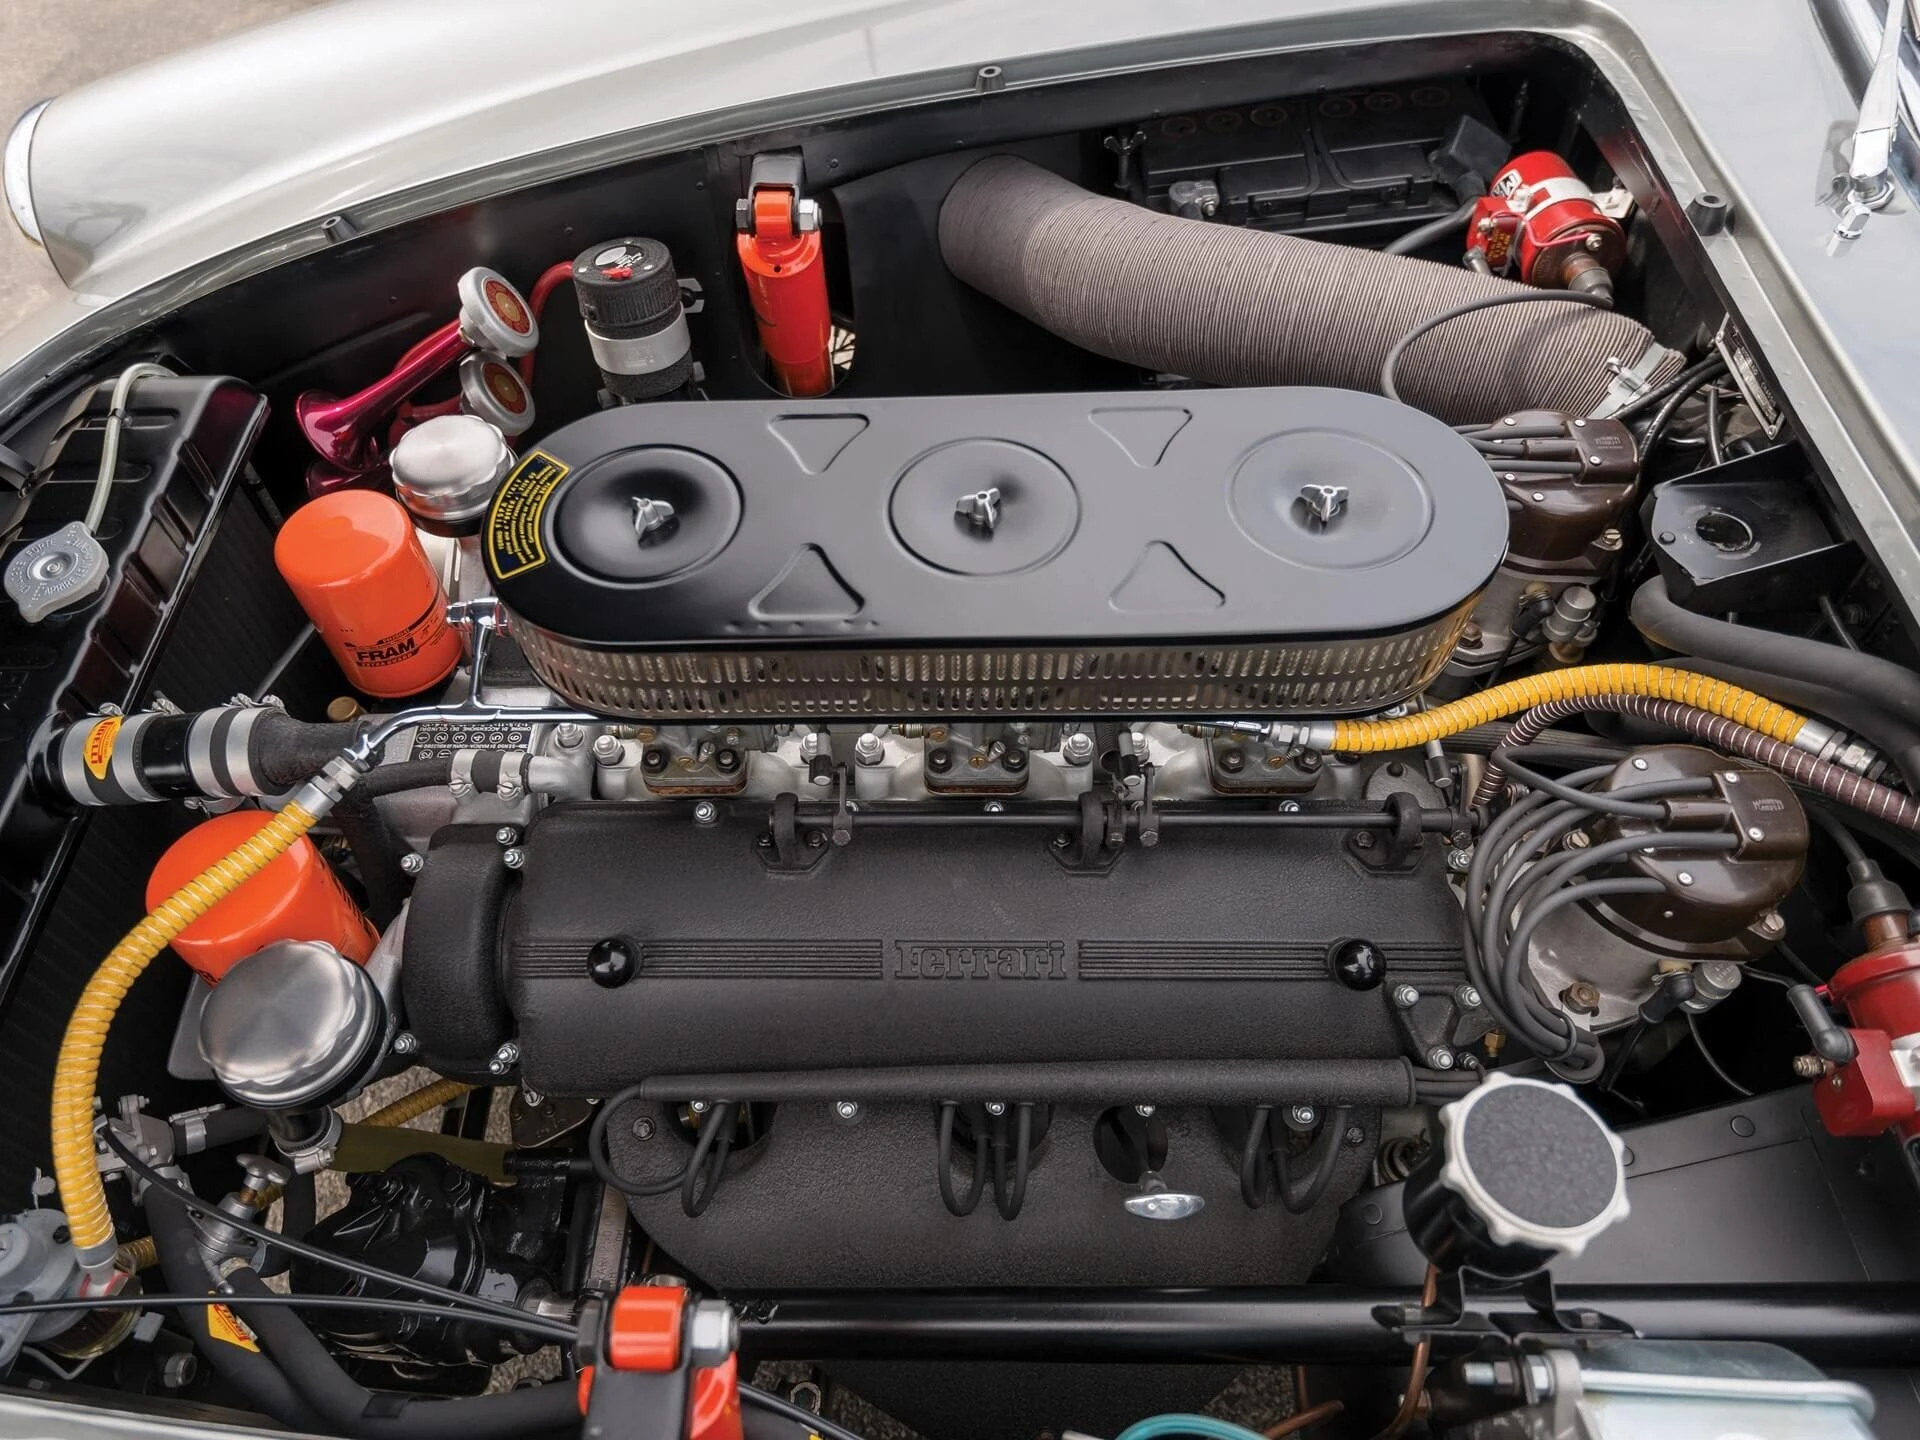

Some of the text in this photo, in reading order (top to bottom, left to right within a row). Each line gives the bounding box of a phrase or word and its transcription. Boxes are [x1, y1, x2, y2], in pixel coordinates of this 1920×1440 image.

[26, 537, 57, 557] FORTE
[355, 636, 415, 661] FRAM
[90, 720, 115, 765] PIRELLI
[894, 939, 1067, 980] Ferrari
